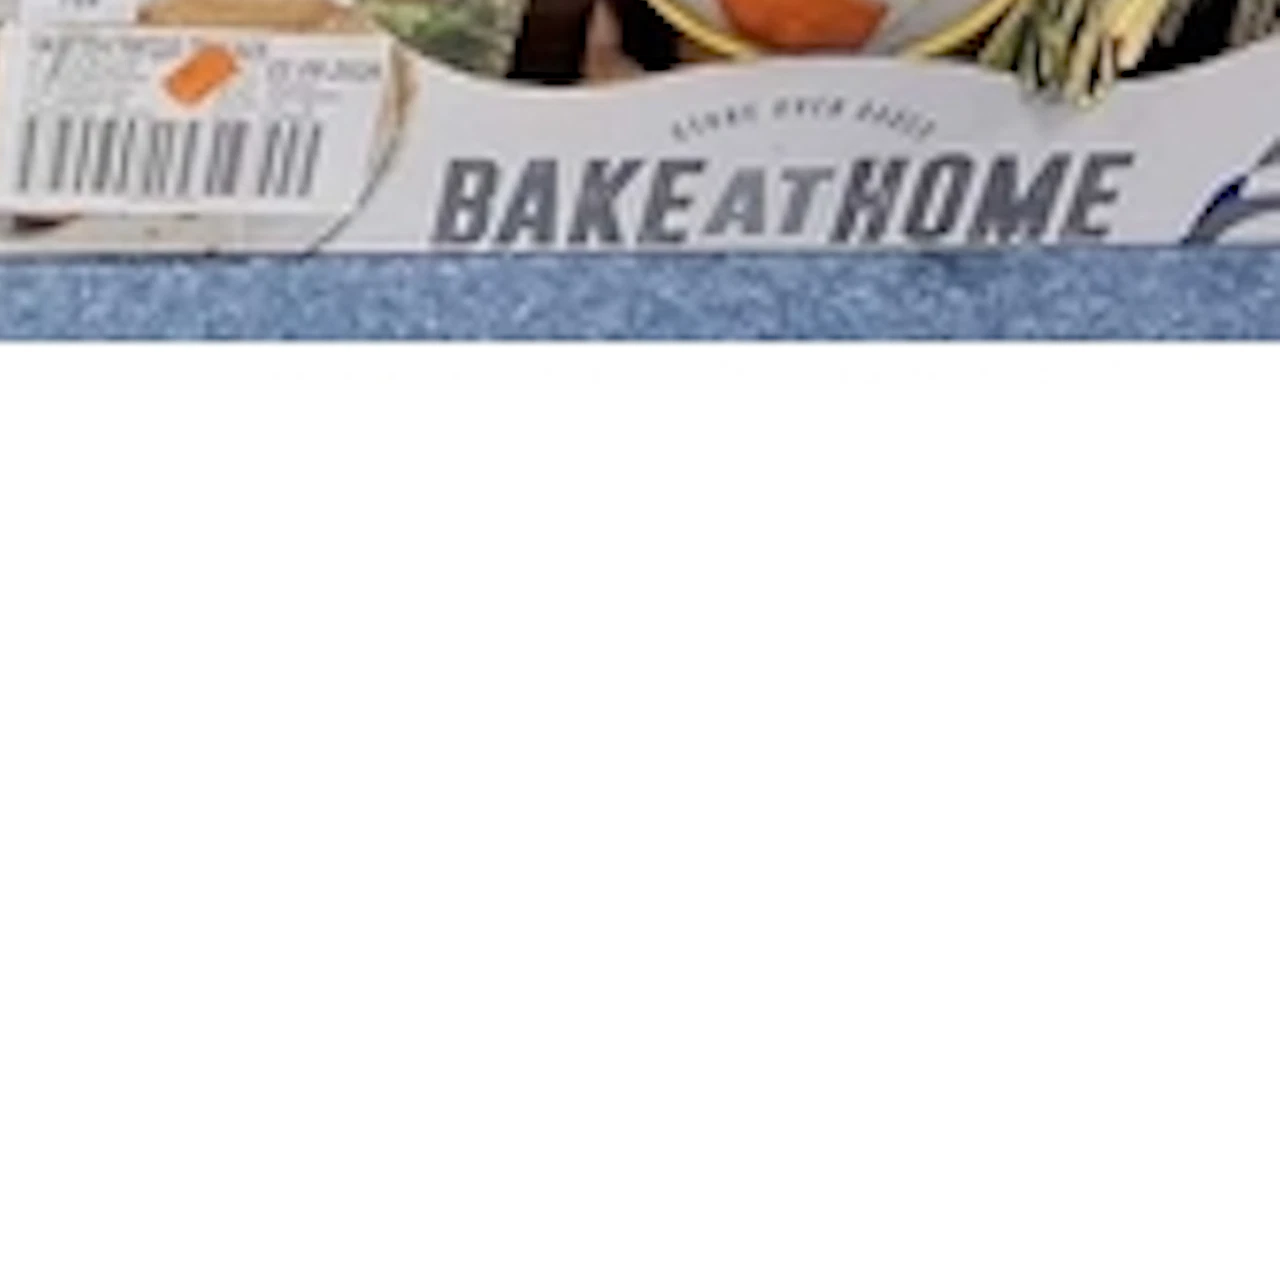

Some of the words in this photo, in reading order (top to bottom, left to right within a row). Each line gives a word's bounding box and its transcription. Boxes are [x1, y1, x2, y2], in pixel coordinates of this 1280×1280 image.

[434, 157, 704, 244] BAKE
[704, 166, 836, 236] AT
[830, 152, 1136, 244] HOME
